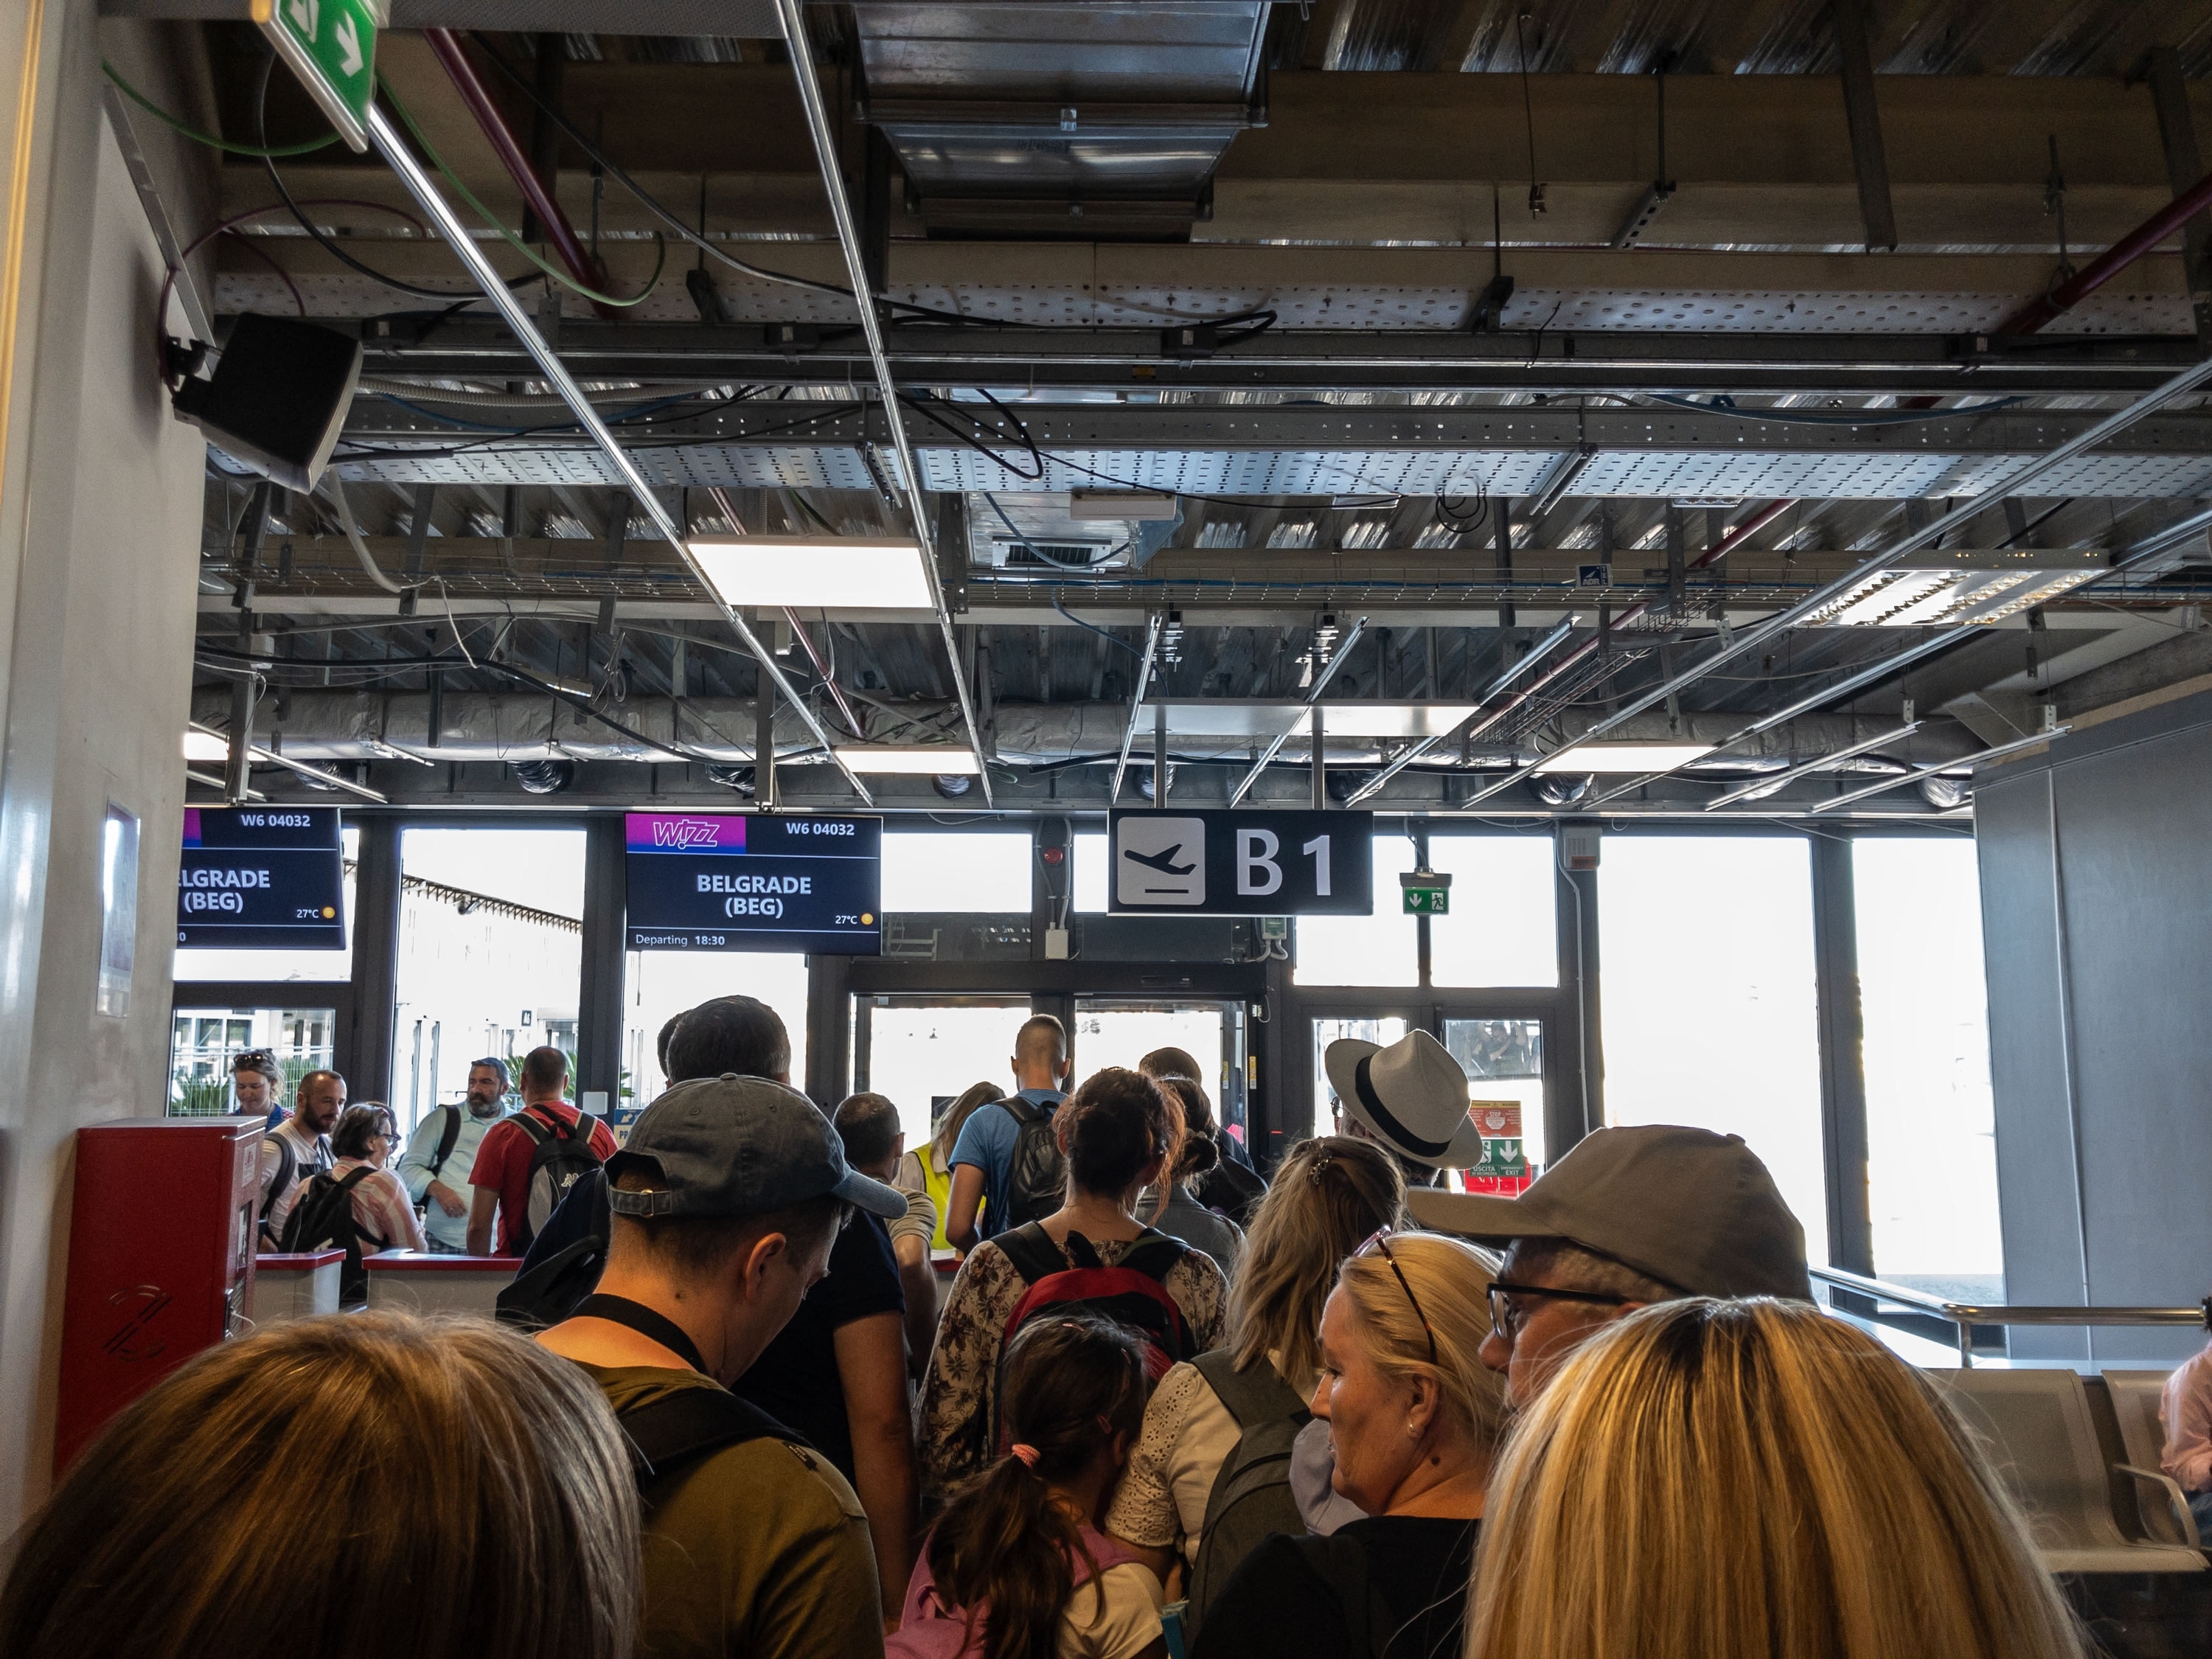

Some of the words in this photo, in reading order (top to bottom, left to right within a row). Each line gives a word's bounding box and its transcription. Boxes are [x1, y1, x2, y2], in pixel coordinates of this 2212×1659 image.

[240, 814, 265, 827] W6
[268, 814, 311, 827] 04032
[785, 822, 810, 835] W6
[813, 823, 855, 836] 04032
[1237, 829, 1283, 896] B
[1303, 835, 1331, 896] 1
[697, 874, 812, 894] BELGRADE
[184, 891, 243, 914] (BEG)
[725, 897, 784, 919] (BEG)
[296, 908, 319, 919] 27°C
[835, 915, 858, 925] 27°C
[636, 933, 688, 947] Departing
[695, 935, 726, 946] 18:30
